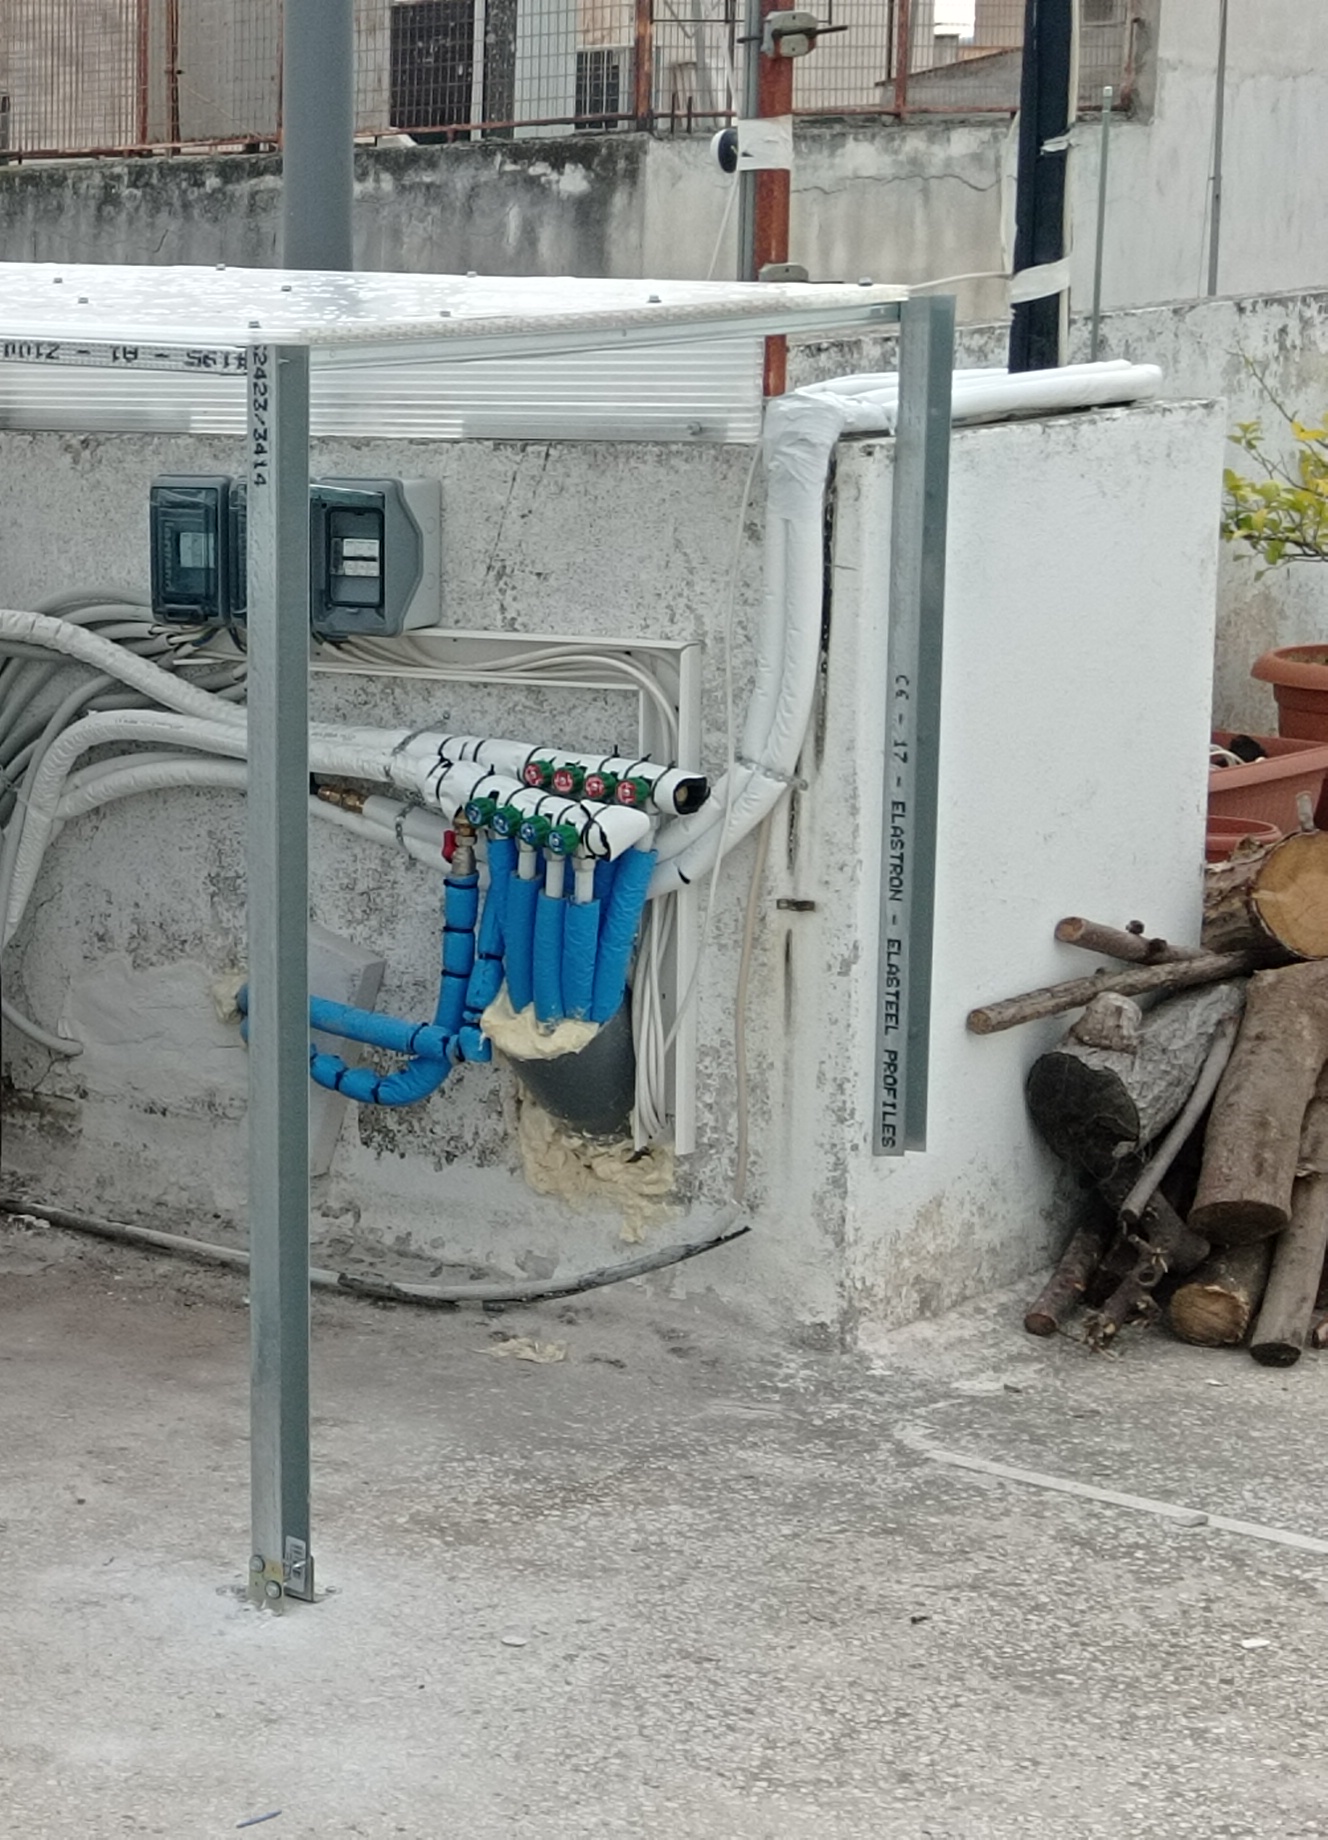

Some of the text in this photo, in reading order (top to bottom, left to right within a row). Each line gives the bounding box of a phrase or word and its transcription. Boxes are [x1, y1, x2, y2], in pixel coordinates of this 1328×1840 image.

[893, 740, 908, 764] 17
[889, 801, 906, 902] ELASTRON
[884, 938, 901, 1036] ELASTEEL
[882, 1049, 898, 1148] PROFILES
